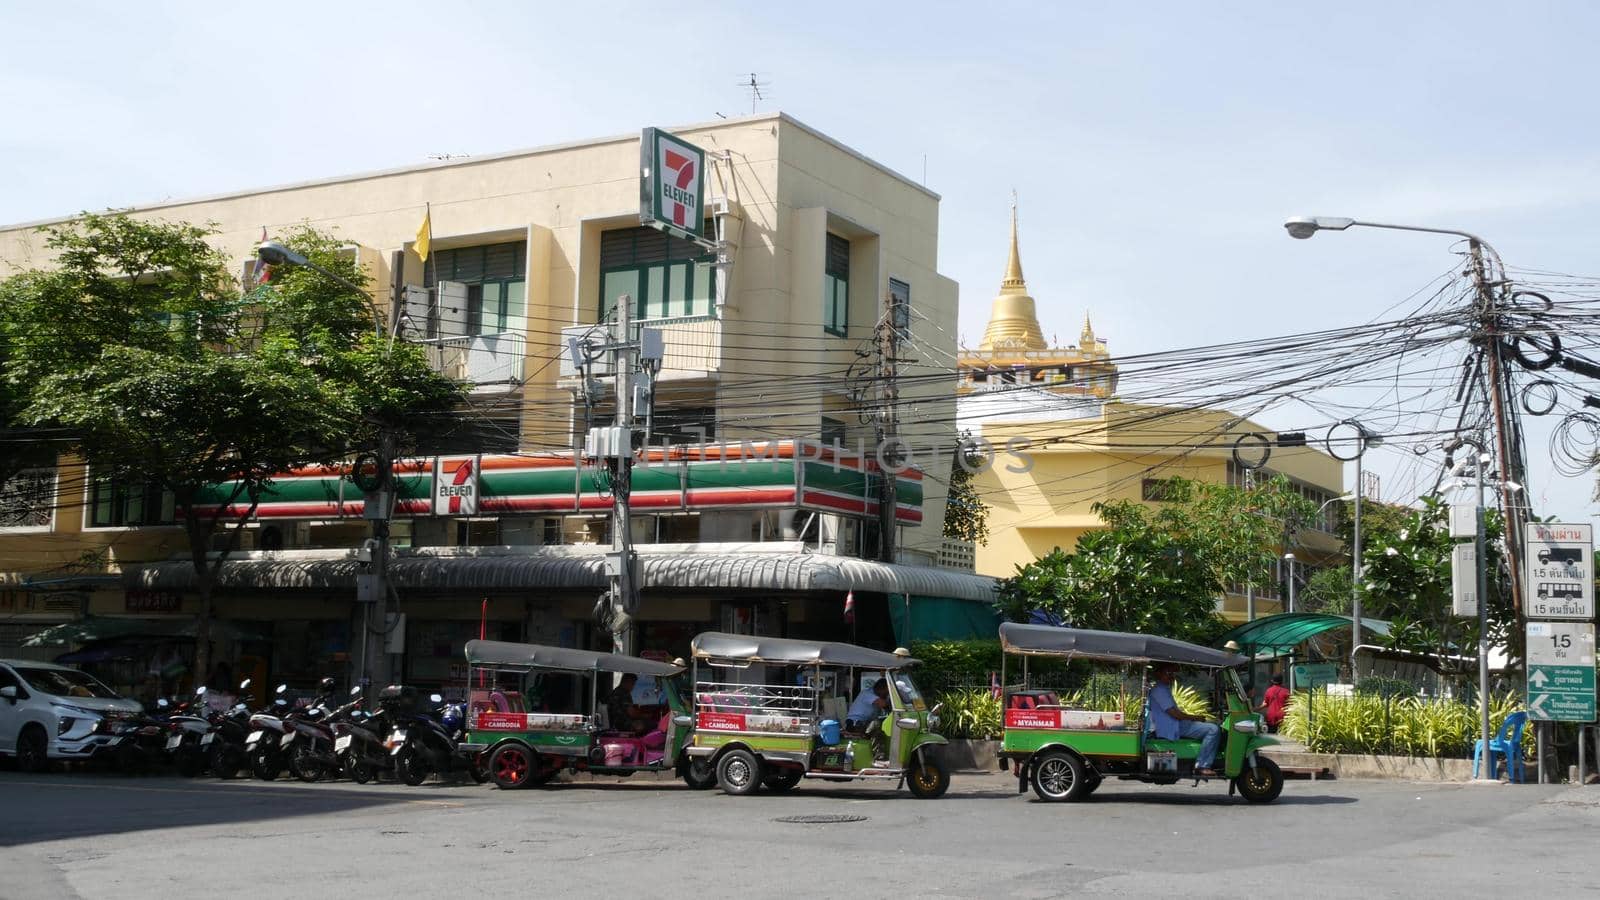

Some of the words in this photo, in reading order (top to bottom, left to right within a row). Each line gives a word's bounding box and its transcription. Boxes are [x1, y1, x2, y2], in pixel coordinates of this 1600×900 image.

[665, 148, 694, 227] 7
[442, 457, 473, 513] 7
[1536, 527, 1582, 540] ห้ามผ่าน
[1533, 568, 1546, 578] 1.5
[1534, 604, 1546, 614] 15
[1550, 634, 1571, 648] 1.5
